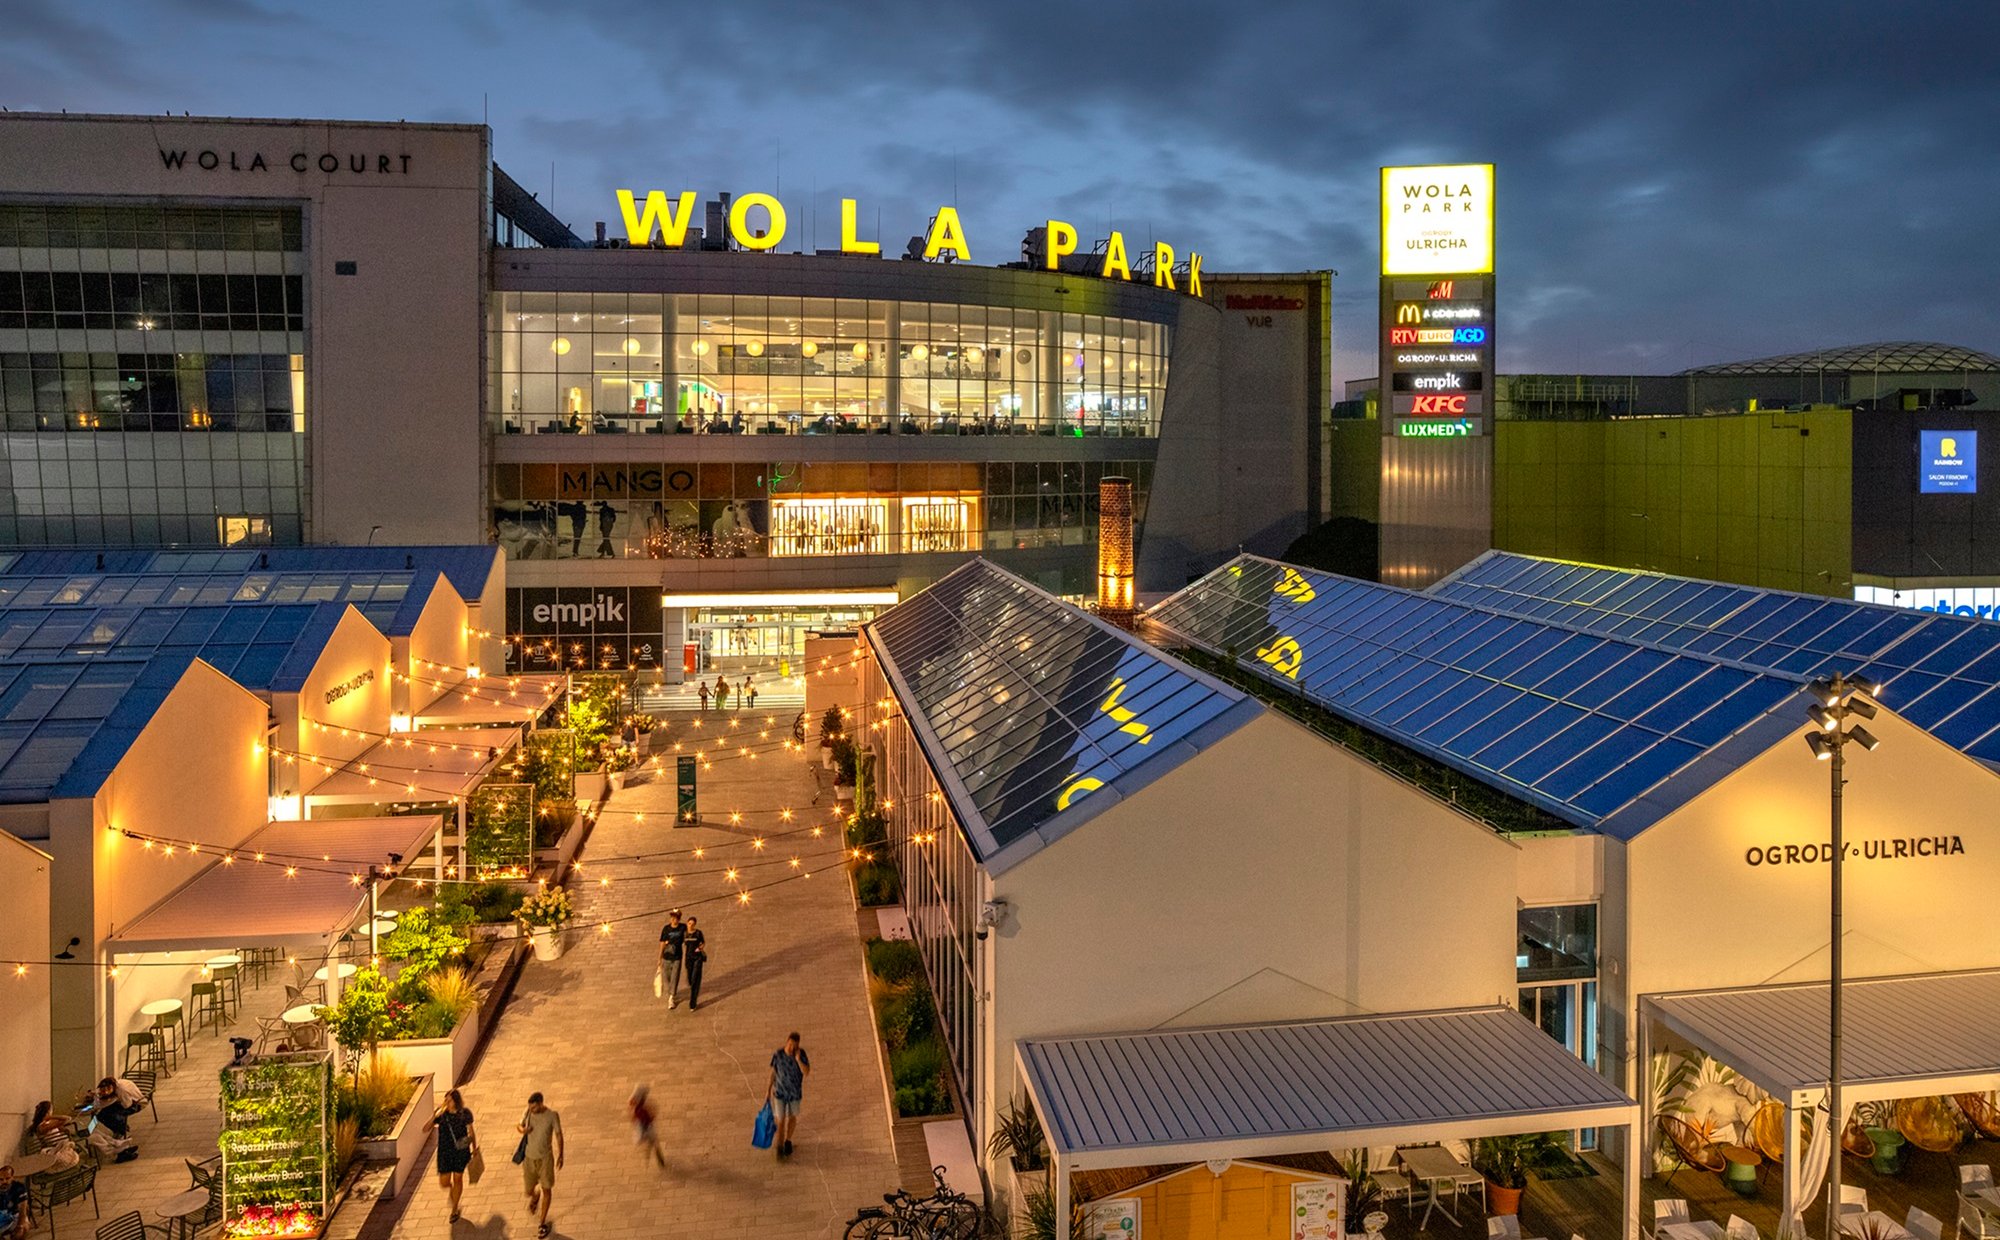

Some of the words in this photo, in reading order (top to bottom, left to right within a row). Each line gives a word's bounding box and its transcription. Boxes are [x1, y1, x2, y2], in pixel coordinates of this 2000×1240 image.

[160, 150, 267, 171] WOLA
[290, 153, 411, 174] COURT
[1403, 184, 1472, 198] WOLA
[1403, 202, 1472, 213] PARK
[616, 189, 970, 261] WOLA
[1046, 219, 1203, 298] PARK
[1406, 239, 1467, 249] ULRICHA
[1246, 316, 1273, 328] vue
[1391, 329, 1418, 344] RTV
[1420, 331, 1453, 341] EURO
[1454, 328, 1485, 343] AGD
[1398, 354, 1435, 362] OGRODY
[1439, 354, 1477, 362] ULRICHA
[1414, 373, 1460, 390] empik
[1411, 395, 1466, 413] KFC
[1402, 424, 1455, 436] LUXMED
[563, 470, 693, 492] MANGO
[533, 593, 624, 627] empik
[1745, 841, 1850, 866] OGRODY
[1864, 836, 1965, 860] ULRICHA
